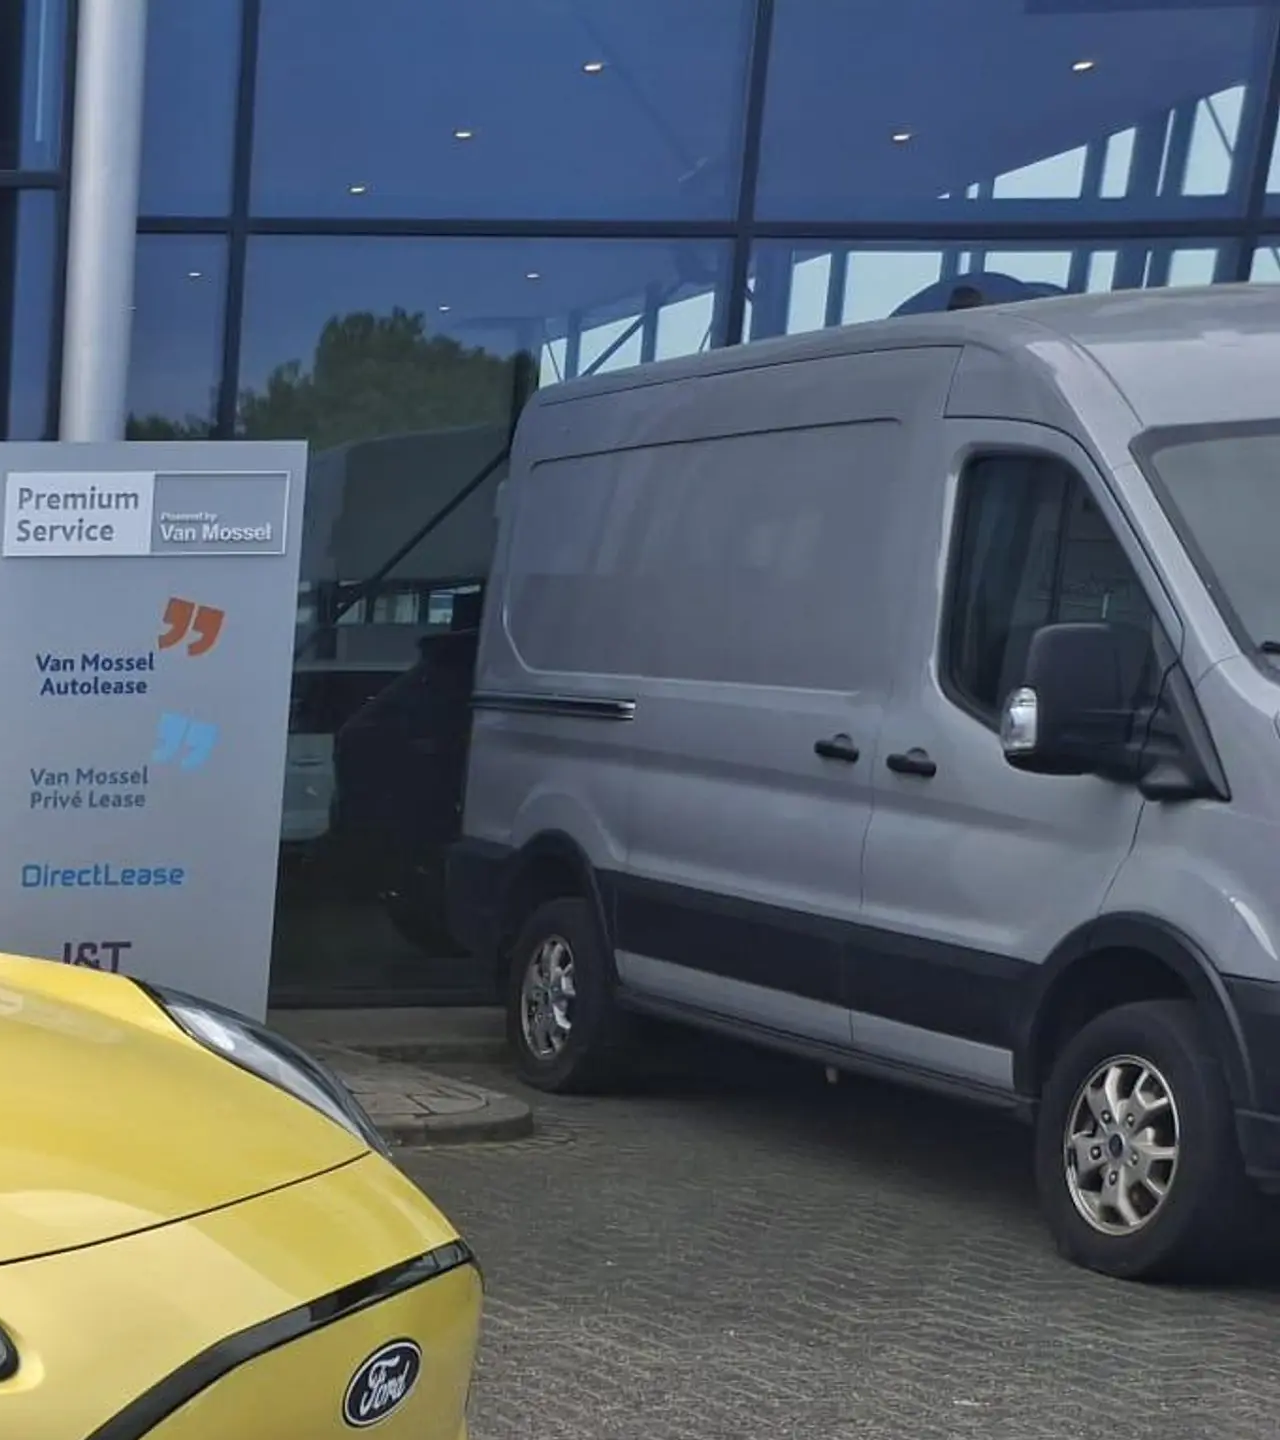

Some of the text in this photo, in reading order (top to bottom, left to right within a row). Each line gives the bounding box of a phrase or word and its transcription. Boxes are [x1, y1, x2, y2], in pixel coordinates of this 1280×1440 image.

[18, 486, 139, 510] Premium
[16, 518, 115, 542] Service
[159, 521, 273, 542] Van Mossel
[36, 651, 155, 672] Van Mossel
[39, 675, 148, 696] Autolease
[29, 765, 149, 786] Van Mossel
[29, 789, 147, 810] Privé Lease
[21, 863, 186, 888] DirectLease
